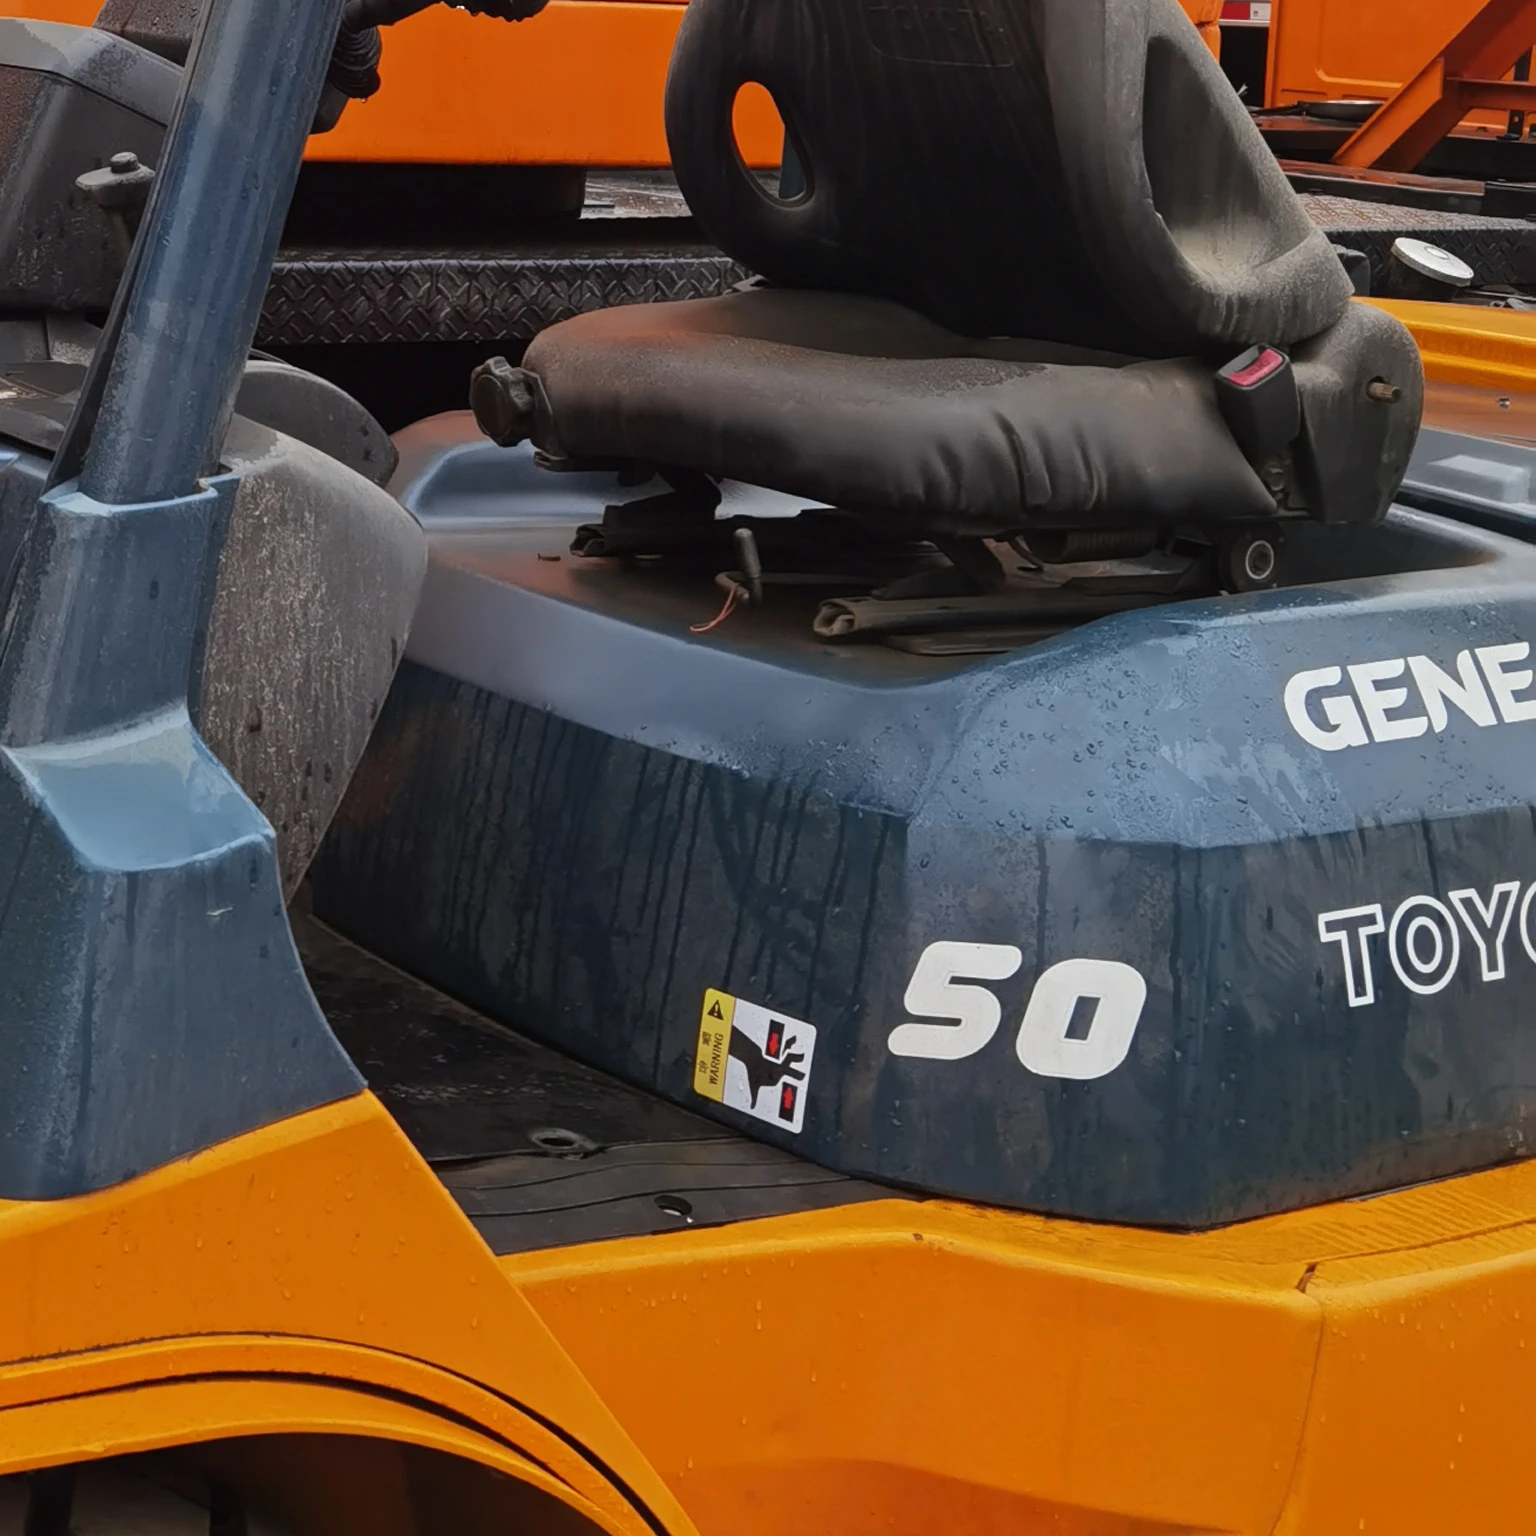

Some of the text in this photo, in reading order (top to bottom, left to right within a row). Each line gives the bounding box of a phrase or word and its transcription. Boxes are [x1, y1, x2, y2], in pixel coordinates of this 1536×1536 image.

[1284, 642, 1536, 751] GENE
[1318, 880, 1536, 1007] TOY
[709, 1032, 724, 1085] WARNING
[888, 940, 1147, 1080] 50
